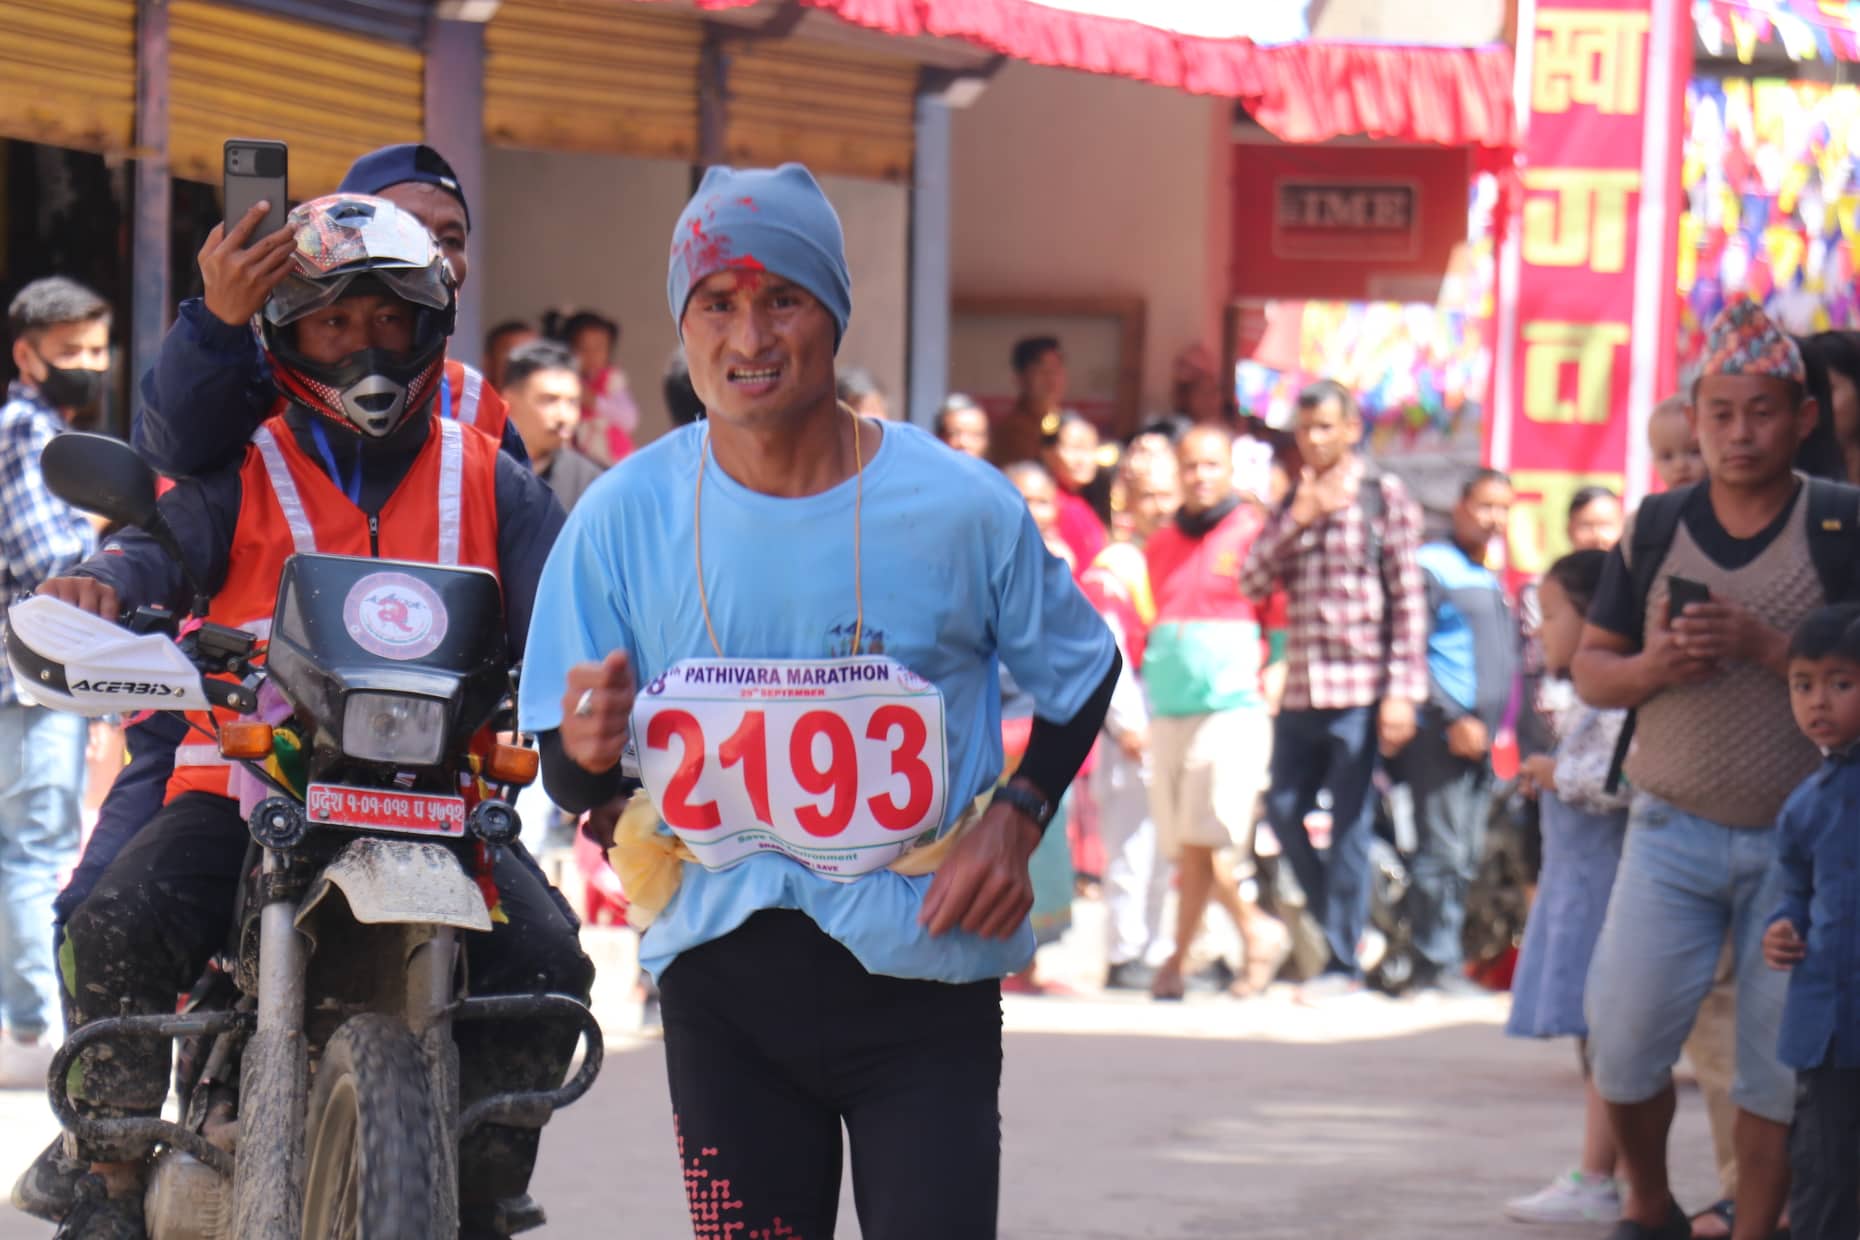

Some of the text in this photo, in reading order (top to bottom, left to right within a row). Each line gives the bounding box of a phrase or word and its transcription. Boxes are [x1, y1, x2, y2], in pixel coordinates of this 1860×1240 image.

[684, 666, 781, 685] PATHIVARA
[786, 664, 889, 684] MARATHON
[646, 704, 934, 838] 2193
[311, 787, 344, 812] प्रदेश
[786, 845, 858, 862] ironment
